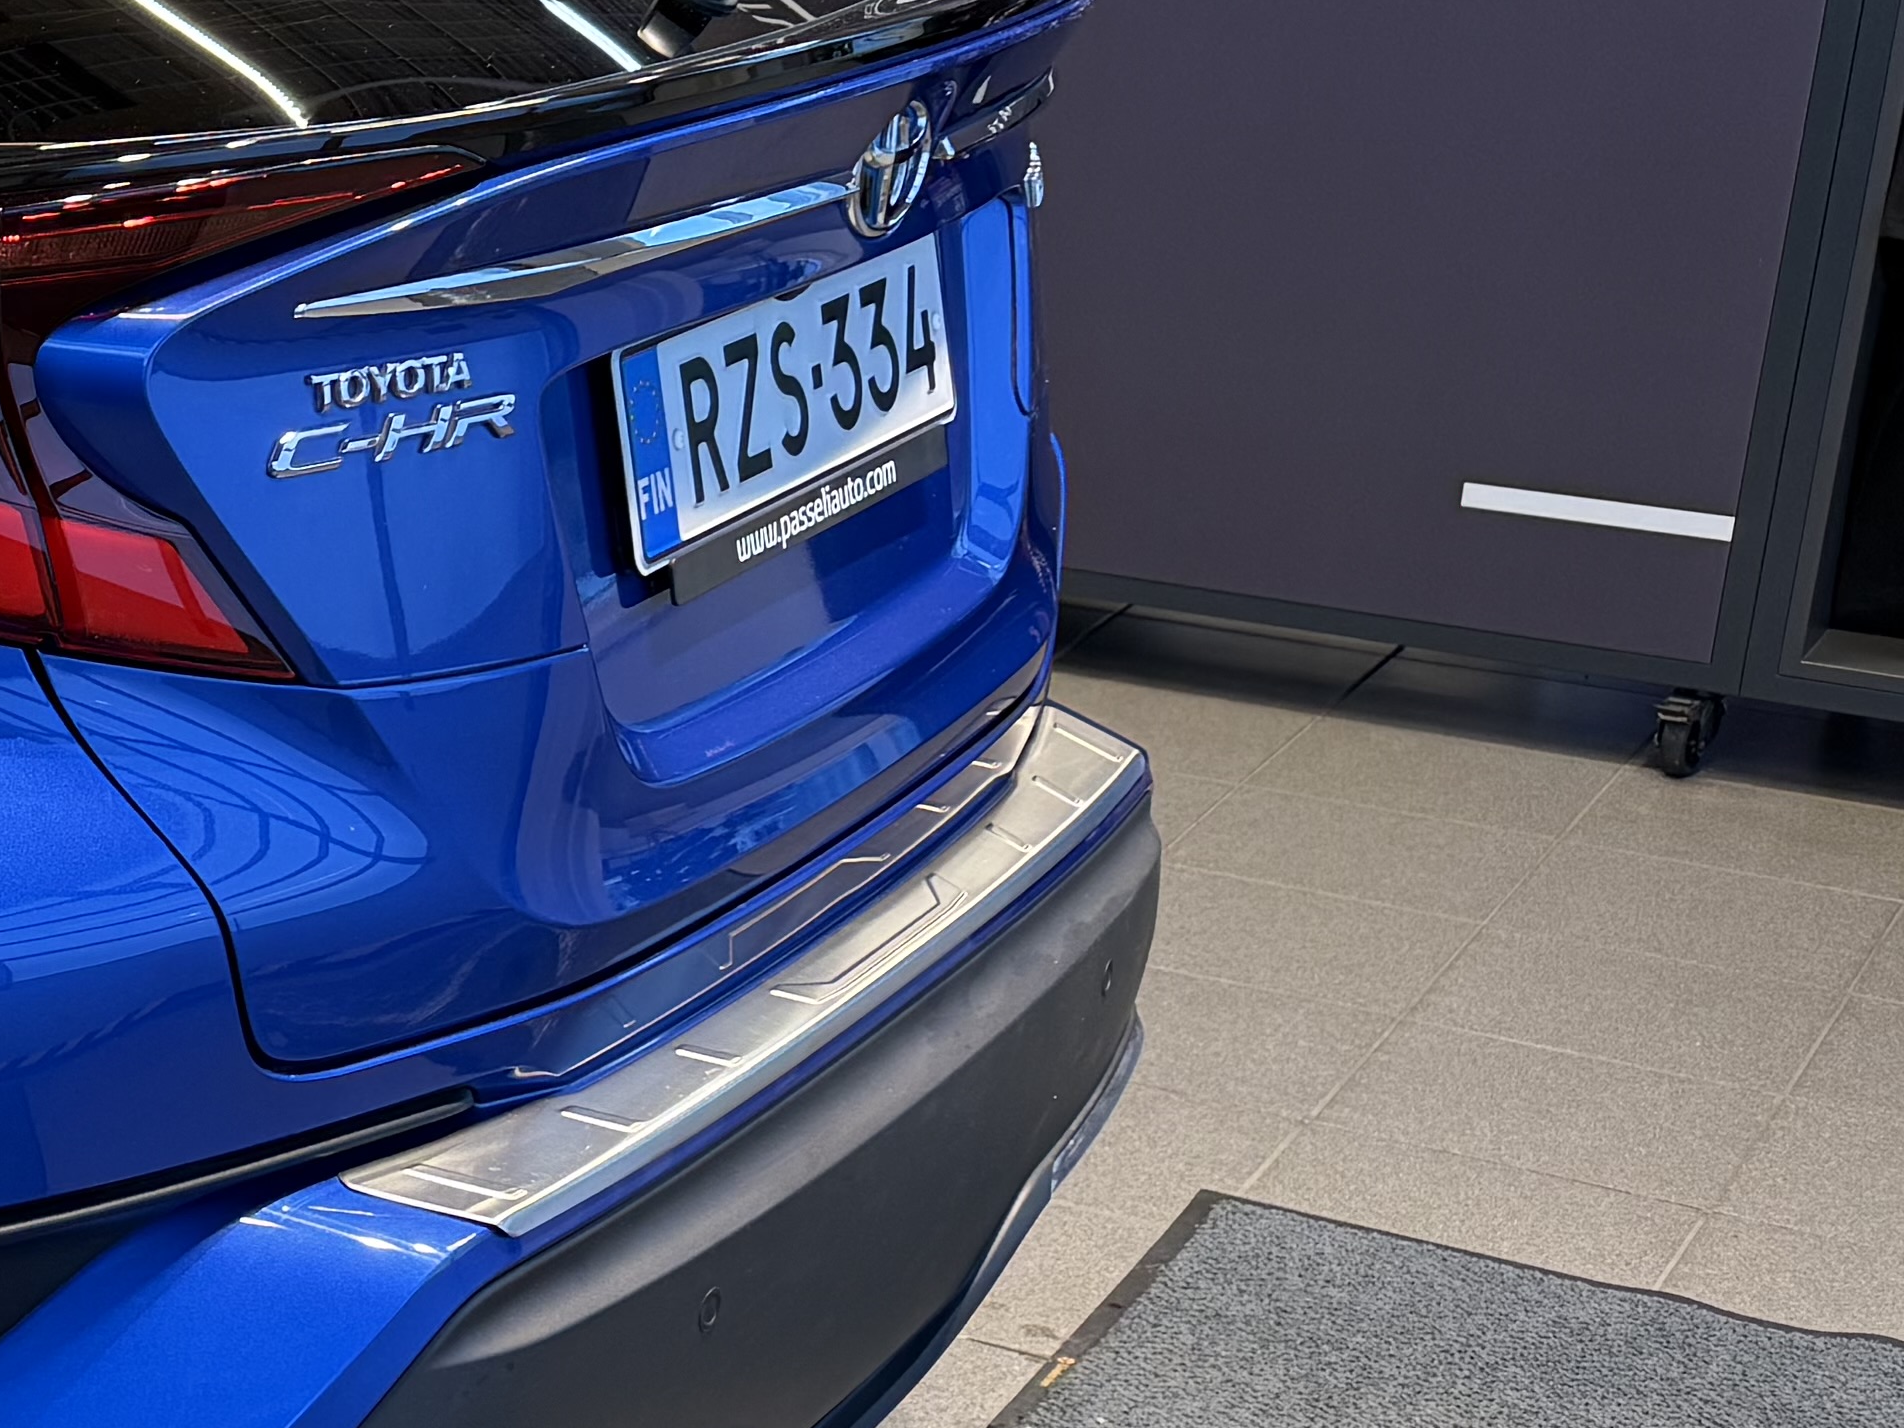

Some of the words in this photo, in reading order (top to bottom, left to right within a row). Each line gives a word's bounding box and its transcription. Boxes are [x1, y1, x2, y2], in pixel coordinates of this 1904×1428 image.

[305, 352, 473, 413] TOYOTA
[678, 263, 937, 508] RZS-334
[266, 401, 517, 479] C-HR
[637, 468, 674, 520] FIN
[734, 459, 898, 563] www.passeliauto.com
